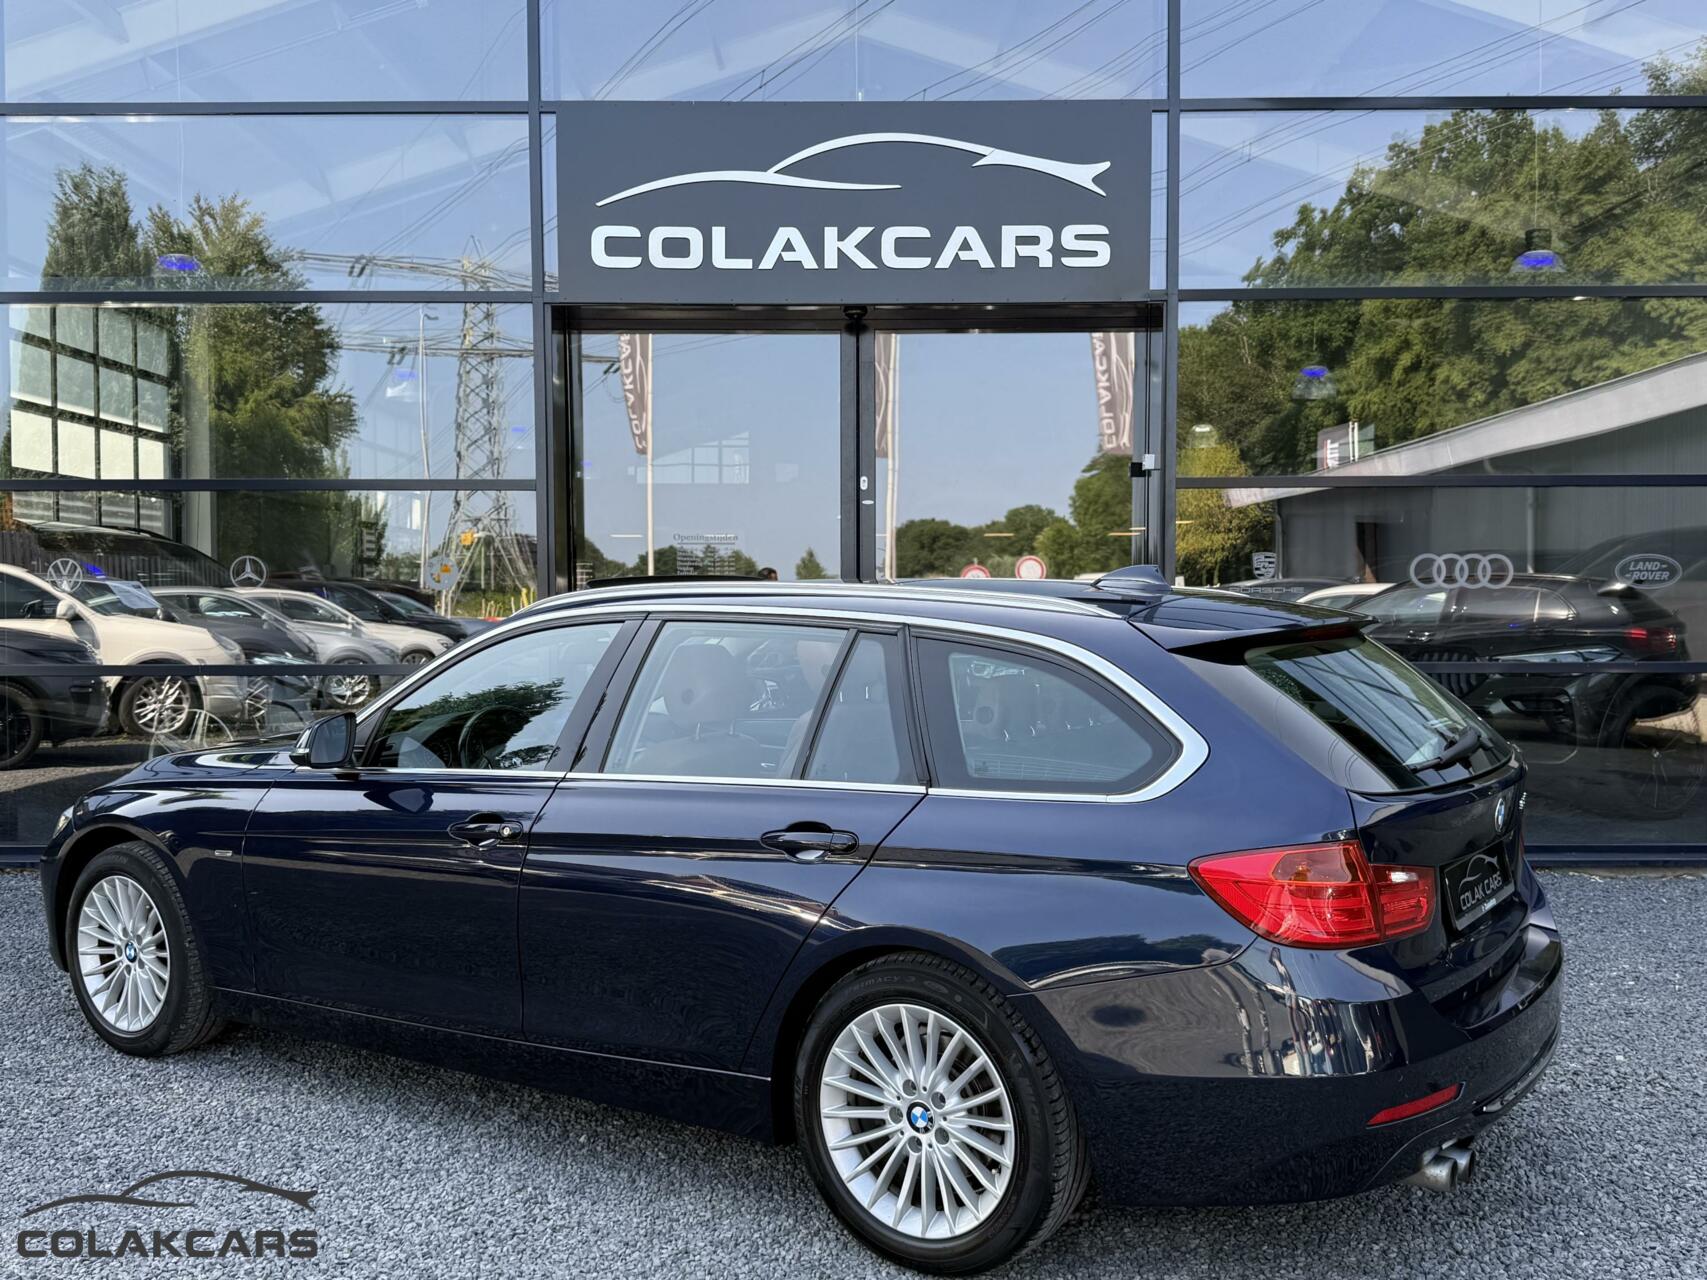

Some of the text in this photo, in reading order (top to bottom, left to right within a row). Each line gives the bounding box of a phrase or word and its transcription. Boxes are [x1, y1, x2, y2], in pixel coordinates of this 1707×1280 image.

[591, 224, 1111, 269] COLAKCARS
[1631, 570, 1670, 580] ROVER
[1460, 883, 1485, 910] COLAK
[1483, 870, 1503, 895] CARS
